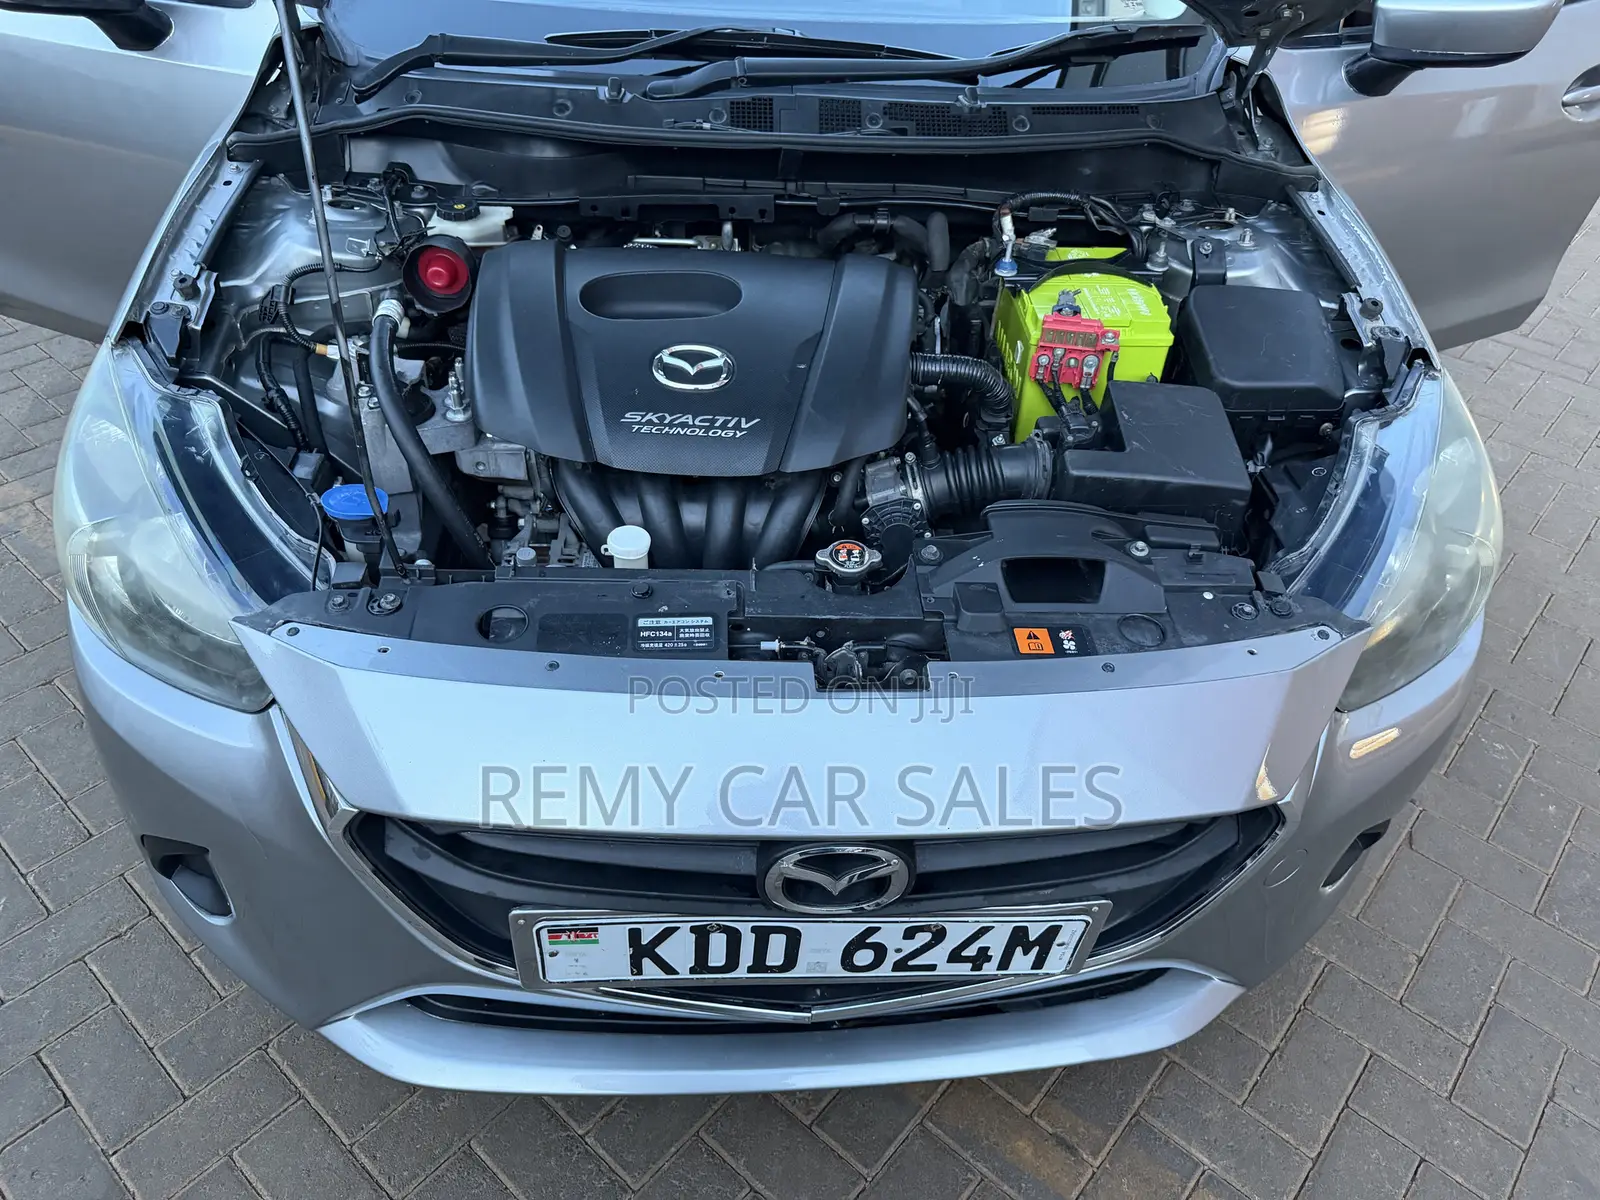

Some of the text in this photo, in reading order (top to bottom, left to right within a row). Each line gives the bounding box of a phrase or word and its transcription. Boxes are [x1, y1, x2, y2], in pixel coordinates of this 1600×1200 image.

[620, 412, 761, 428] SKYACTIV
[631, 425, 747, 438] TECHNOLOGY
[628, 925, 802, 976] KDD
[840, 924, 1063, 973] 624M
